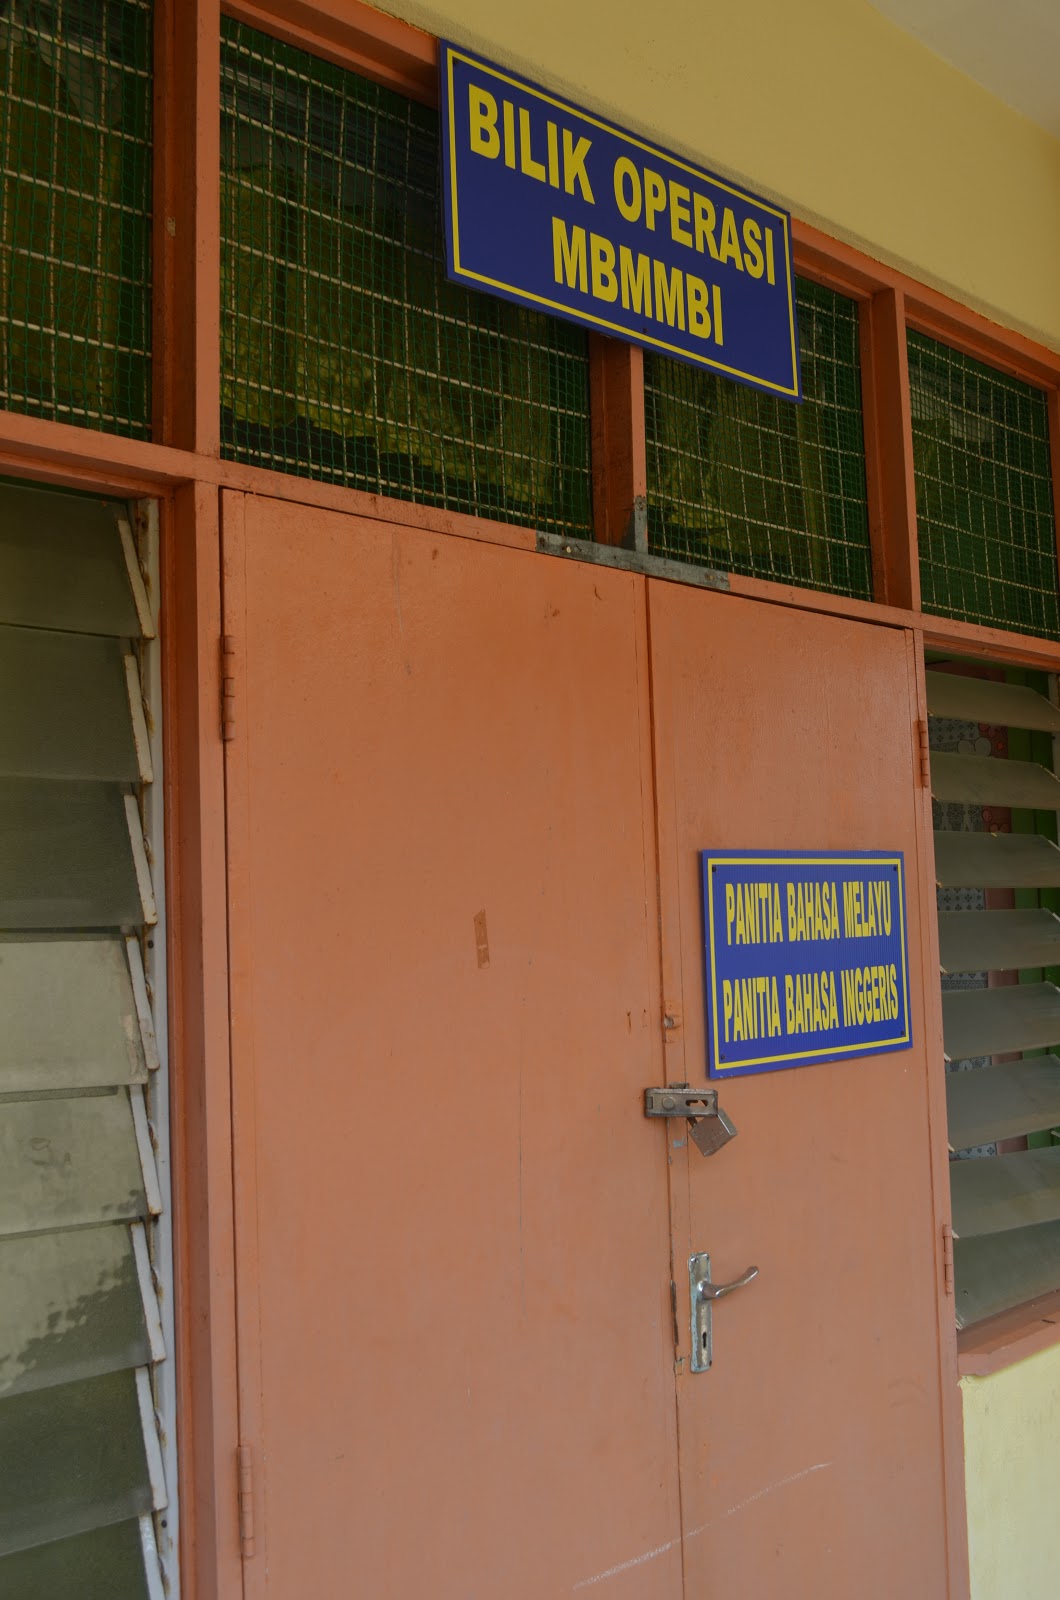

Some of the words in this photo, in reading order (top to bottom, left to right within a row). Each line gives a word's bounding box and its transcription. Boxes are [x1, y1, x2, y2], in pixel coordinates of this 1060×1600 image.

[468, 84, 595, 204] BILIK
[614, 156, 776, 285] OPERASI
[552, 216, 724, 346] MBMMBI
[725, 883, 783, 945] PANITIA
[787, 881, 840, 941] BAHASA
[843, 881, 892, 938] MELAYU
[723, 976, 782, 1043] PANITIA
[784, 970, 839, 1034] BAHASA
[841, 963, 899, 1027] INGGERIS
